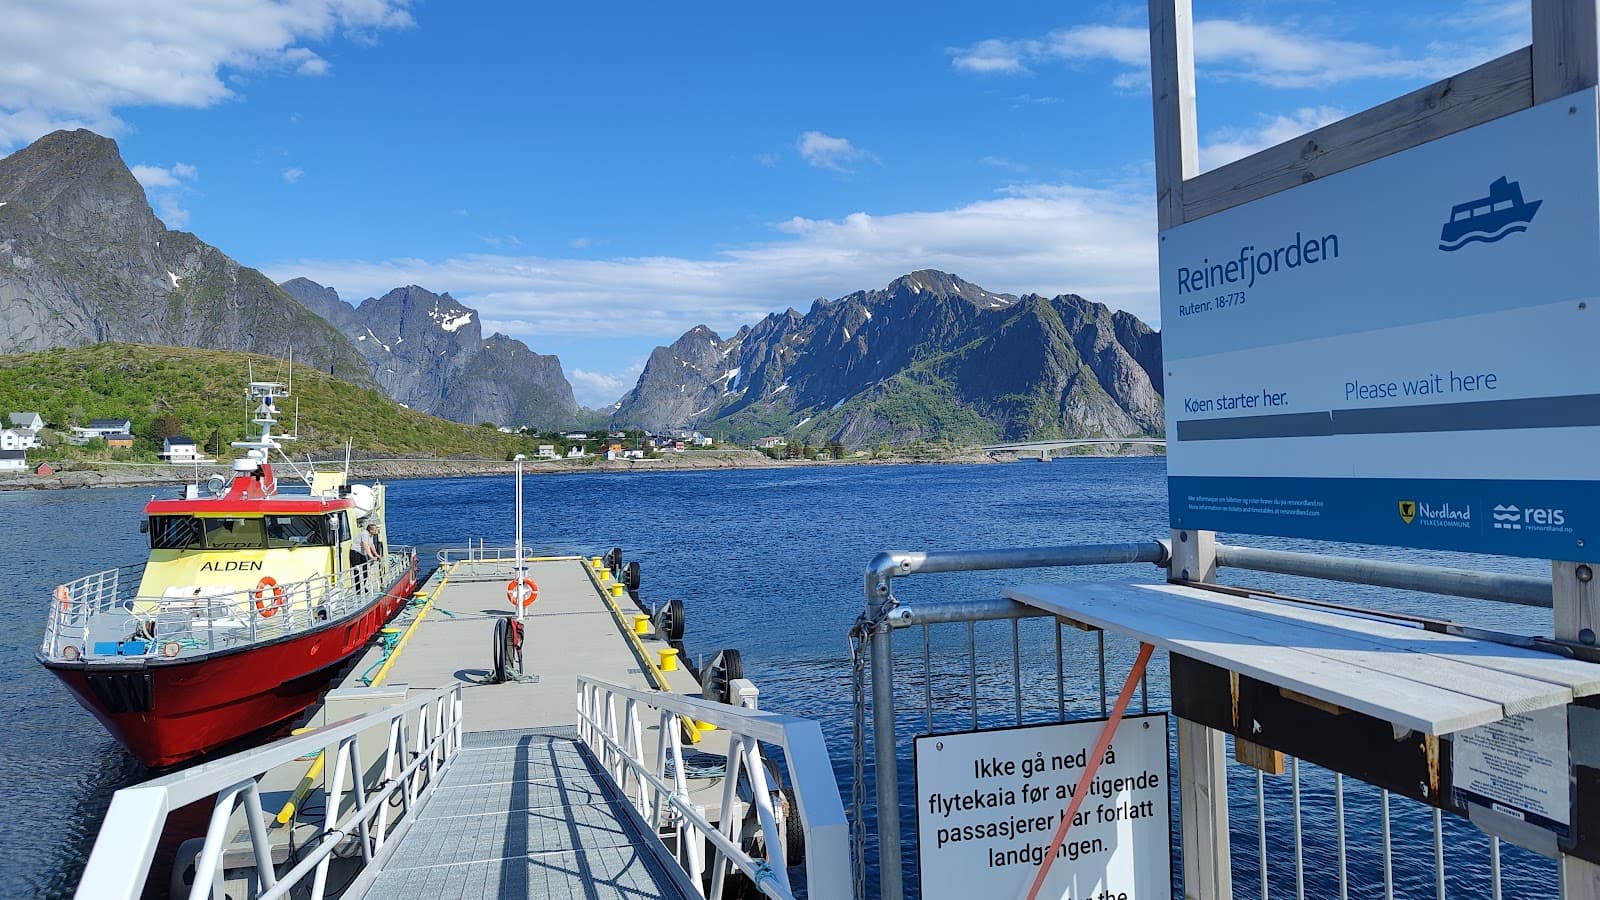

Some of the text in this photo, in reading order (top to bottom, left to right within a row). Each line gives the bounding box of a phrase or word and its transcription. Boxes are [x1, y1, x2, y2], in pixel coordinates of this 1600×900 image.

[1177, 232, 1339, 295] Reinefjorden
[1179, 291, 1246, 317] Rutenr. 18-773
[1345, 370, 1498, 401] Please wait here
[1184, 389, 1289, 414] Køen starter her.
[1419, 502, 1471, 521] Nordland
[1524, 508, 1565, 525] reis
[1420, 520, 1471, 529] FYLKESKOMMUNE
[1525, 525, 1574, 534] reisnordland.no
[200, 561, 263, 572] ALDEN
[975, 744, 1116, 779] Ikke gå ned å
[928, 770, 1159, 818] flytekaia før avtigende
[937, 815, 1055, 849] passasjerer
[1096, 800, 1154, 824] forlatt
